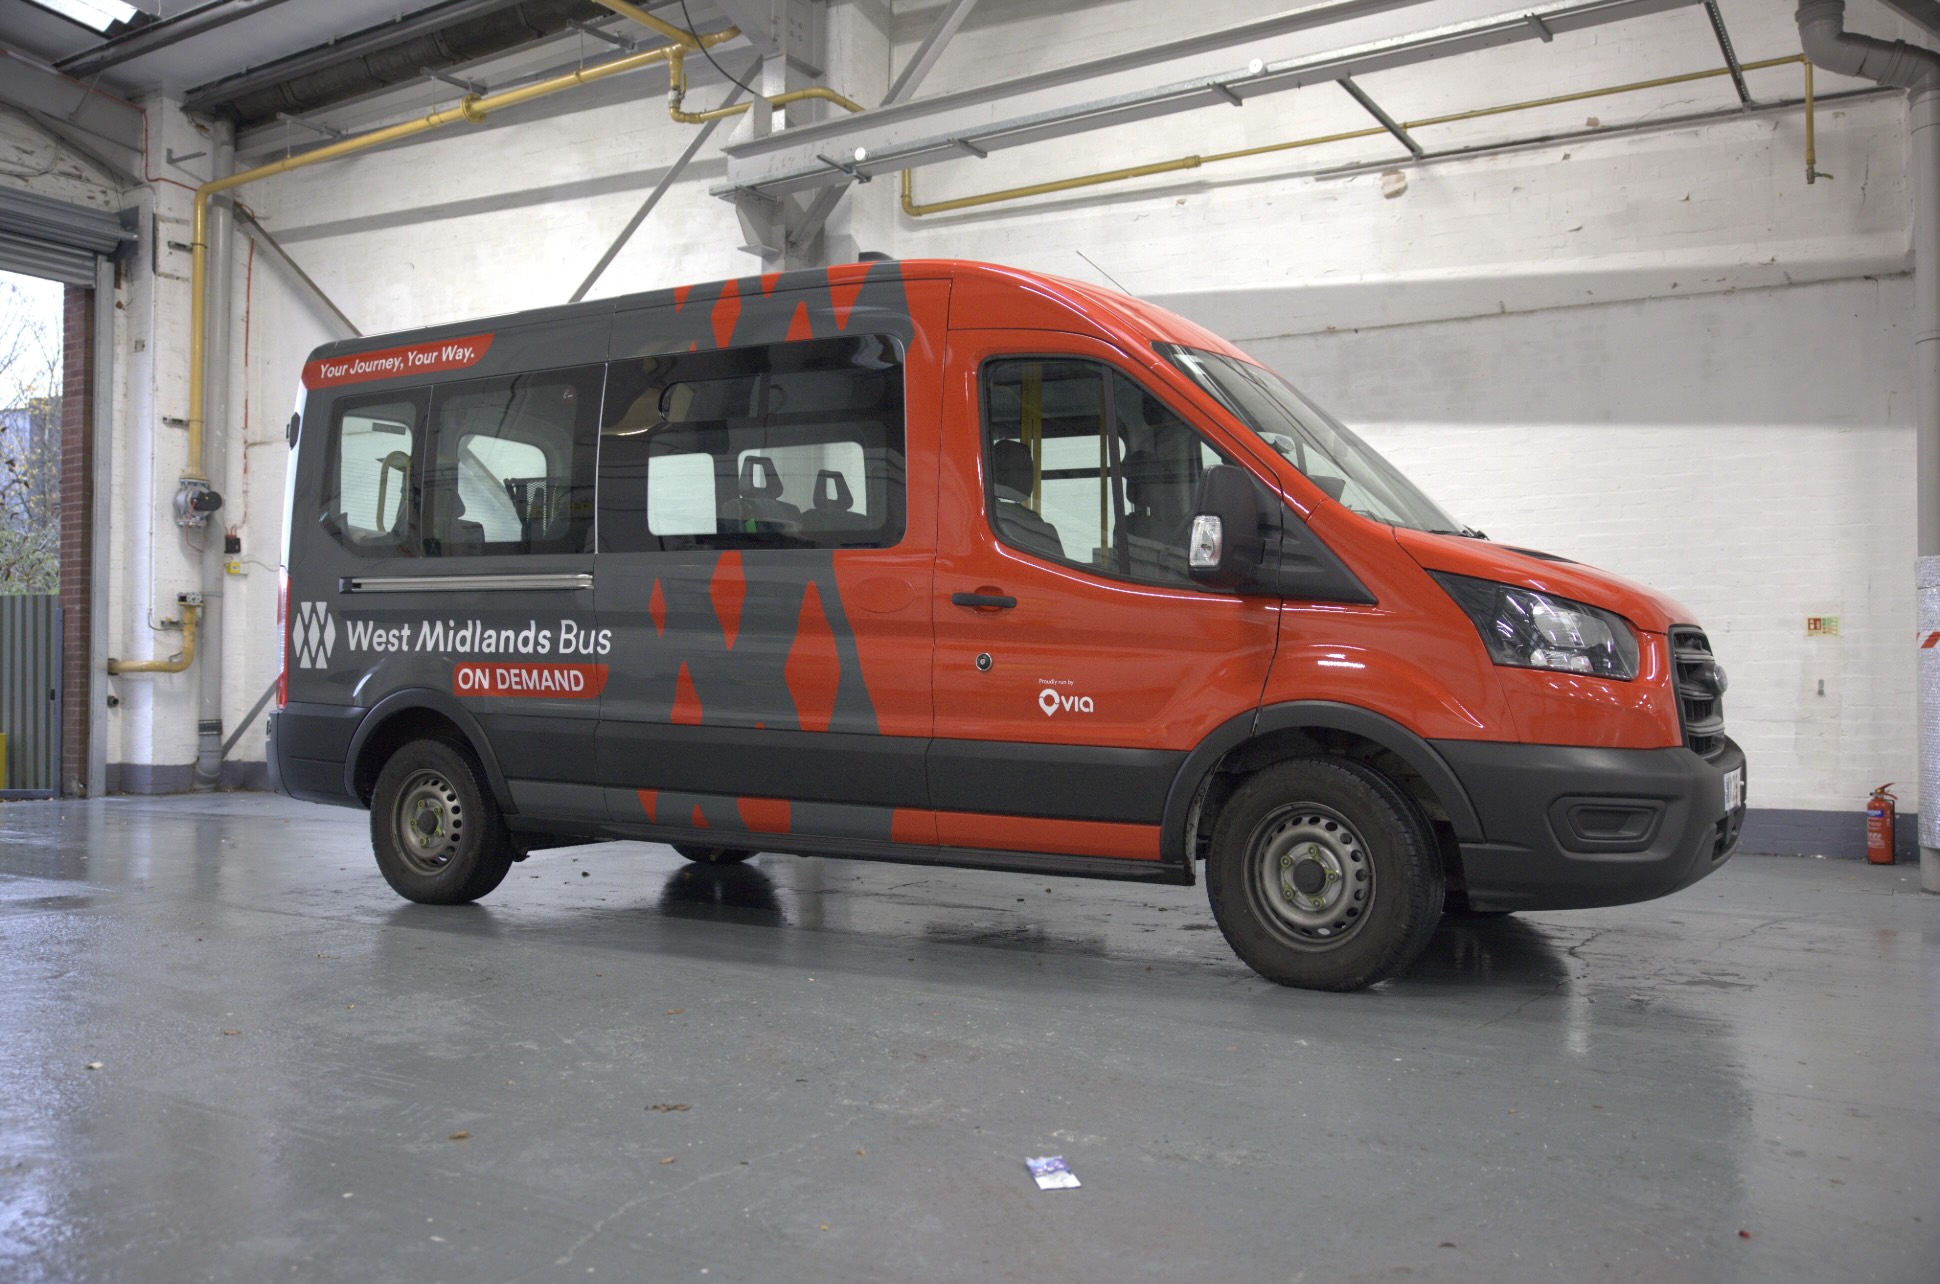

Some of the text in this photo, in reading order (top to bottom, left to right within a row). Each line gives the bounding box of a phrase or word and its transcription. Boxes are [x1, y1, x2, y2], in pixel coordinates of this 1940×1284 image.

[320, 345, 475, 378] Your Journey, Your Way.
[346, 619, 612, 654] West Midlands Bus
[458, 668, 584, 692] ON DEMAND
[1061, 695, 1094, 712] via
